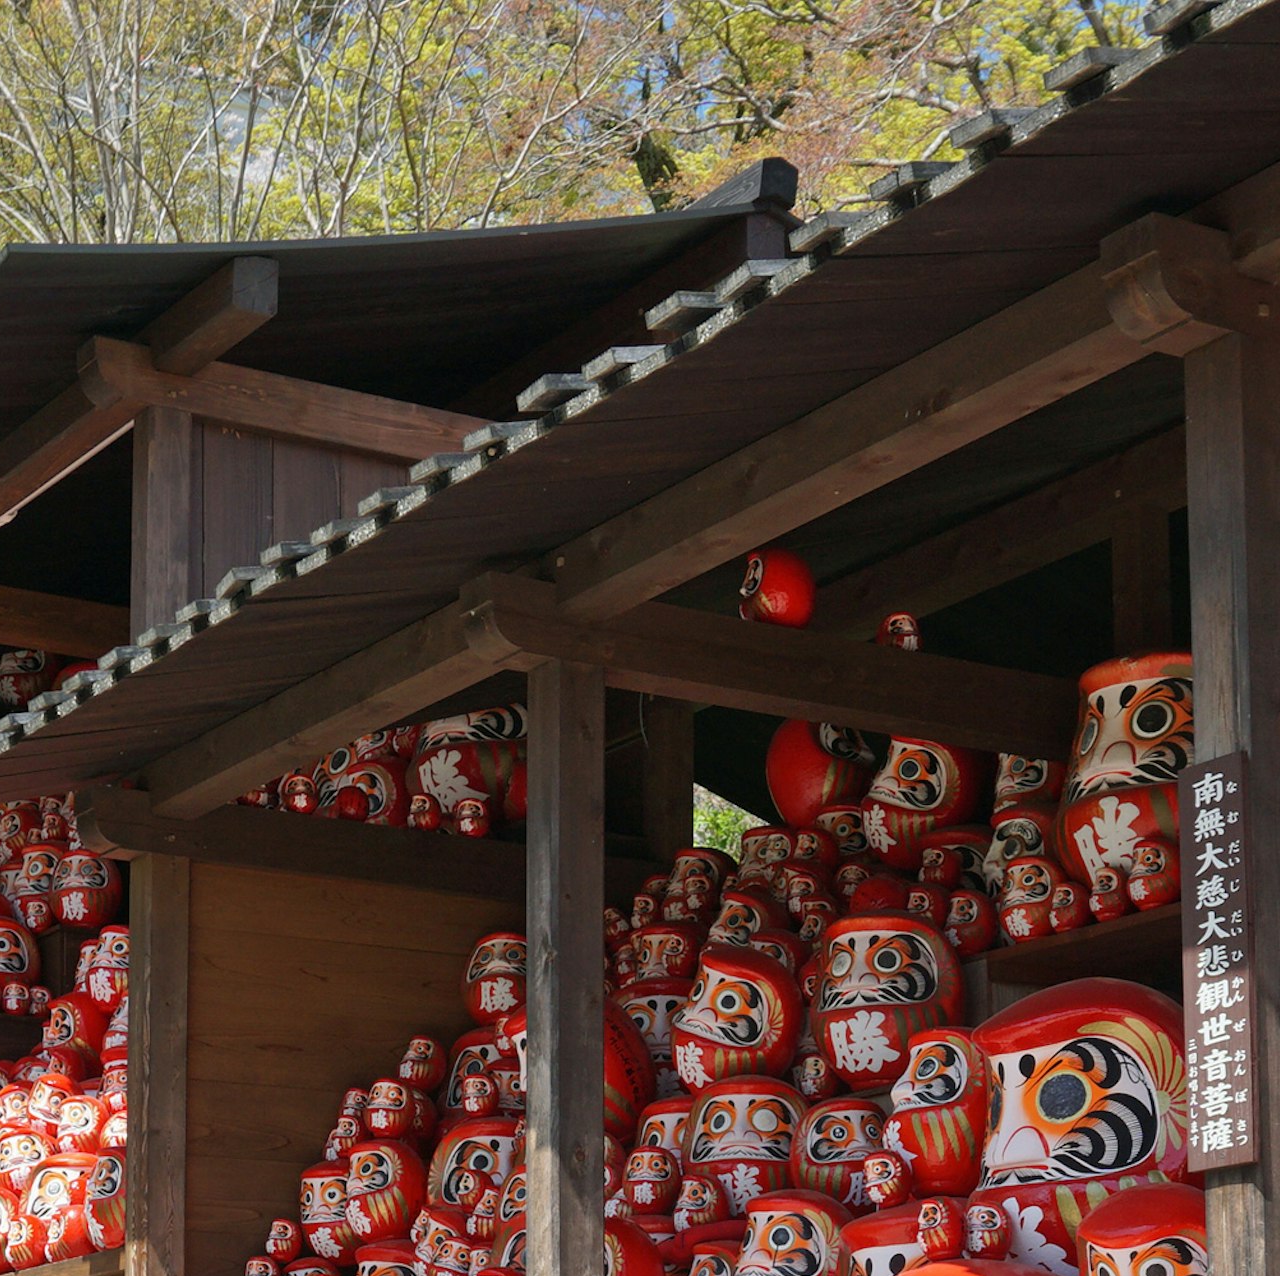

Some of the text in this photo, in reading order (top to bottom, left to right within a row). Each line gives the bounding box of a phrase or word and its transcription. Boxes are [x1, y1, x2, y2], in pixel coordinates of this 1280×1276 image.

[419, 749, 490, 812] 勝
[863, 804, 896, 853] 勝
[61, 892, 88, 920] 勝
[89, 969, 116, 1002] 勝
[1191, 771, 1234, 1154] 南無大慈大悲観世音菩薩
[479, 978, 518, 1012] 勝
[676, 1042, 713, 1089] 勝
[829, 1011, 902, 1073] 勝
